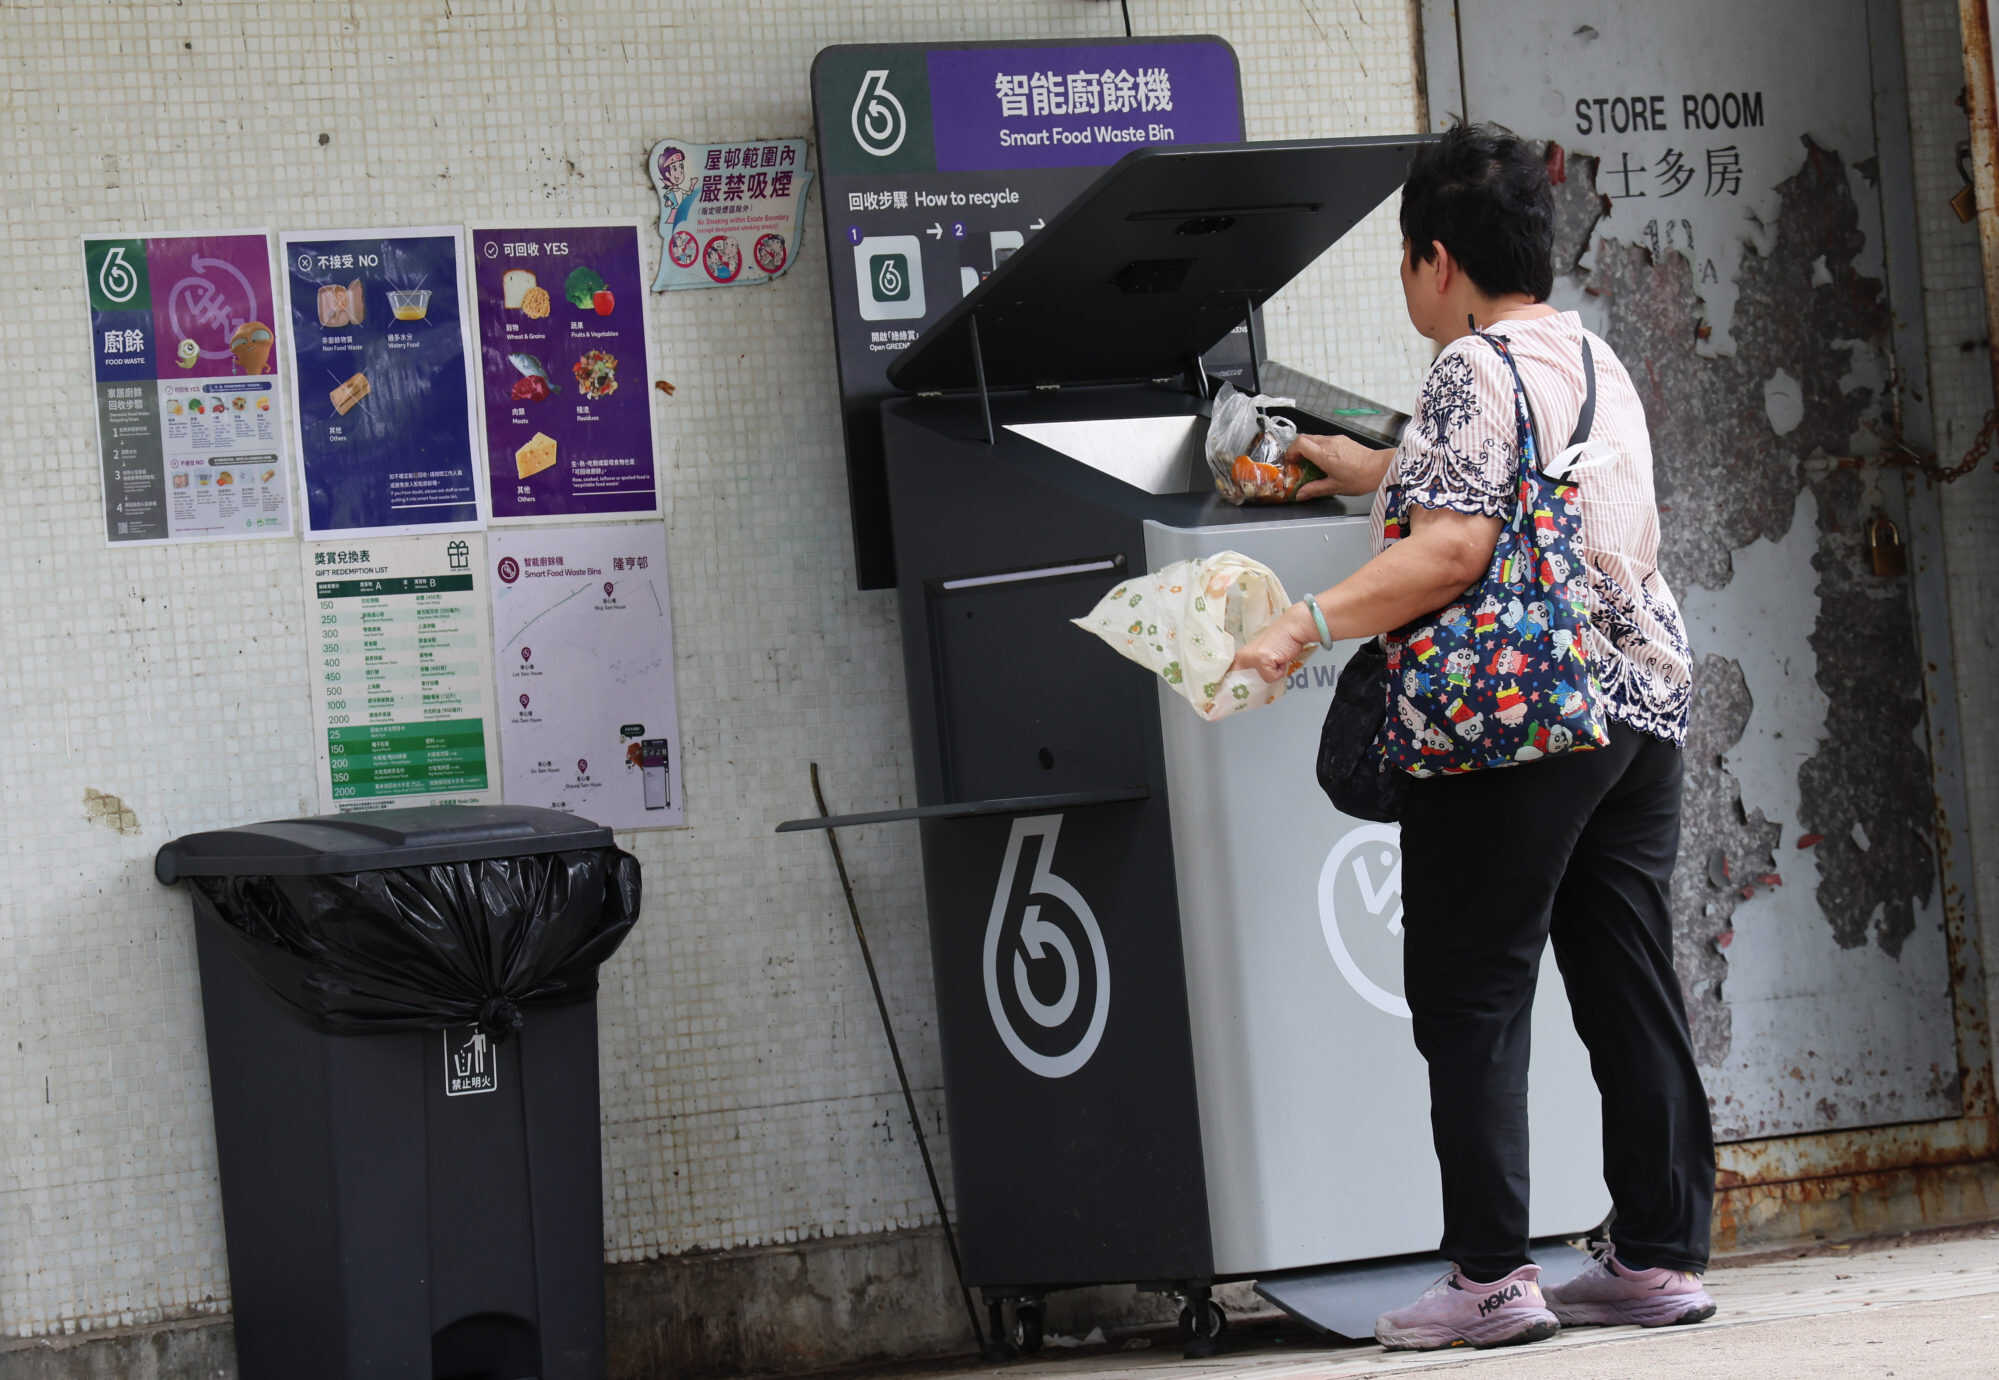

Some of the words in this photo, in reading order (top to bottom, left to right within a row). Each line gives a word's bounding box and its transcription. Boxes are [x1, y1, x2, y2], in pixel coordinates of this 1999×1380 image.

[995, 68, 1173, 117] 智能廚餘機
[1576, 96, 1666, 135] STORE
[1682, 92, 1764, 130] ROOM
[1000, 128, 1049, 146] Smart
[1052, 127, 1091, 145] Food
[1094, 125, 1146, 143] Waste
[1149, 124, 1174, 141] Bin
[705, 145, 795, 170] 屋邨範圍內
[1606, 146, 1743, 198] 士多房
[700, 170, 793, 203] 嚴禁吸煙
[849, 191, 908, 211] 回收步驟
[915, 191, 947, 207] How
[950, 192, 966, 205] to
[969, 188, 1019, 208] recycle
[852, 229, 857, 240] 1
[955, 224, 963, 236] 2
[503, 242, 540, 257] 可回收
[544, 242, 569, 255] YES
[317, 254, 354, 269] 不接受
[359, 254, 378, 267] NO
[104, 329, 144, 353] 廚餘
[113, 449, 119, 460] 2
[114, 470, 121, 480] 3
[116, 503, 123, 513] 4
[331, 568, 374, 576] REDEMPTION
[524, 570, 546, 578] Smart
[547, 569, 564, 577] Food
[375, 582, 382, 590] A
[321, 615, 337, 625] 250
[324, 658, 340, 668] 400
[325, 672, 341, 682] 450
[1288, 667, 1309, 690] od
[326, 686, 342, 696] 500
[327, 700, 346, 710] 1000
[328, 714, 350, 724] 2000
[331, 745, 345, 753] 150
[332, 759, 349, 768] 200
[333, 773, 349, 783] 350
[334, 787, 356, 797] 2000
[452, 1075, 491, 1091] 禁止明火
[1478, 1283, 1522, 1318] HOKA
